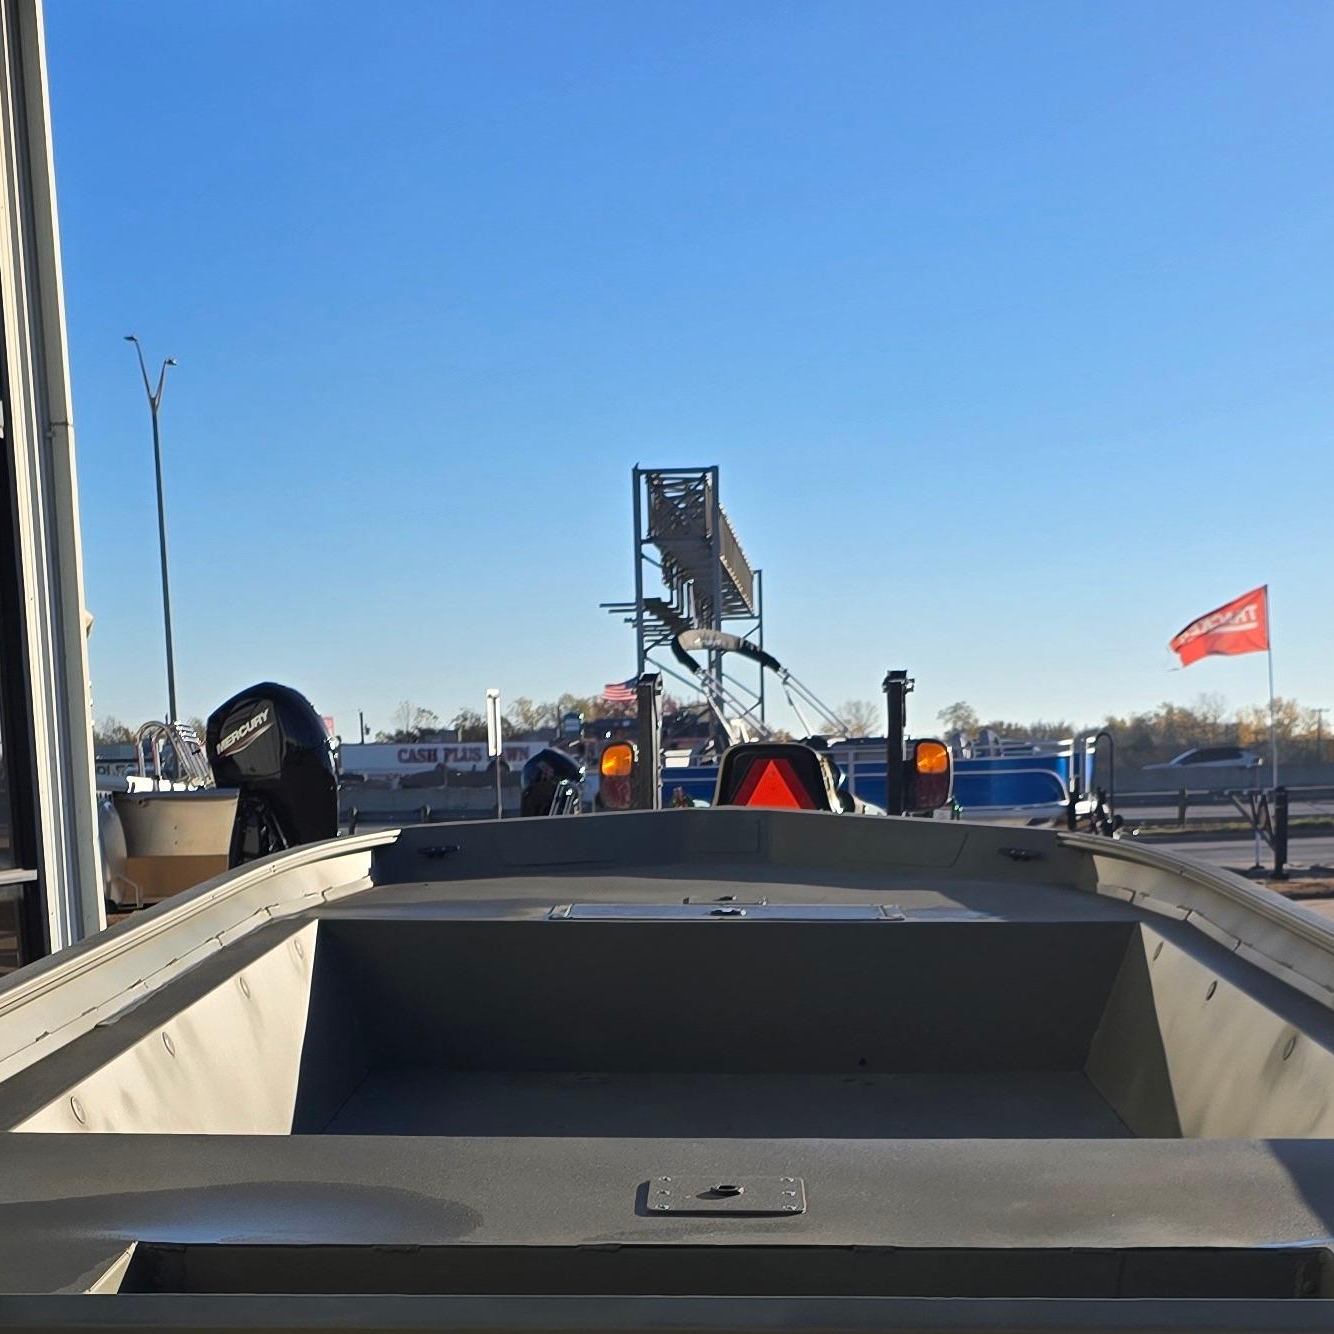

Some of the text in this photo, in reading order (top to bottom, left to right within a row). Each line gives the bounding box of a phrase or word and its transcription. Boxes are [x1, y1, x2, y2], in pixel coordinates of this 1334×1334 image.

[216, 708, 269, 755] MERCURY
[397, 747, 437, 763] CASH
[443, 747, 482, 763] PLUS
